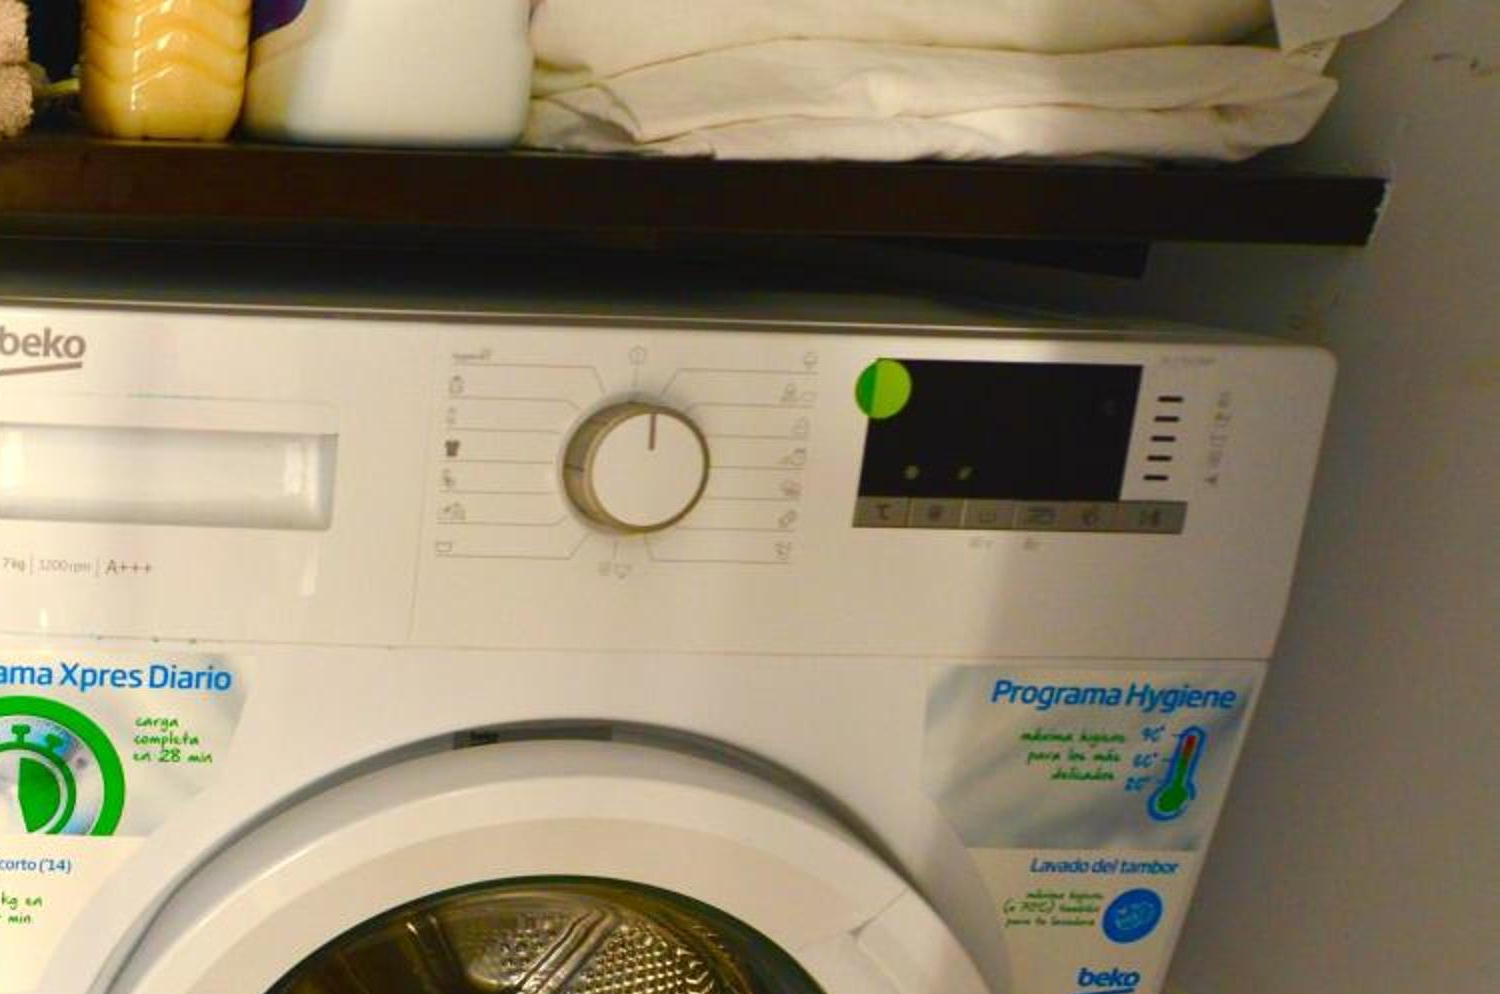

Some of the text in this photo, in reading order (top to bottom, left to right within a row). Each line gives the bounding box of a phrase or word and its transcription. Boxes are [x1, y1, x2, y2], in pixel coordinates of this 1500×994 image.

[59, 662, 143, 693] Xpres
[148, 664, 234, 692] Diario
[991, 679, 1238, 714] Programa Hygiene
[134, 715, 180, 732] carga
[132, 731, 200, 747] completa
[132, 749, 214, 764] en 28 min
[1029, 858, 1180, 875] Lavado del tambor
[0, 891, 18, 910] kg
[25, 896, 44, 907] en
[7, 912, 32, 924] min
[1076, 966, 1142, 987] beko
